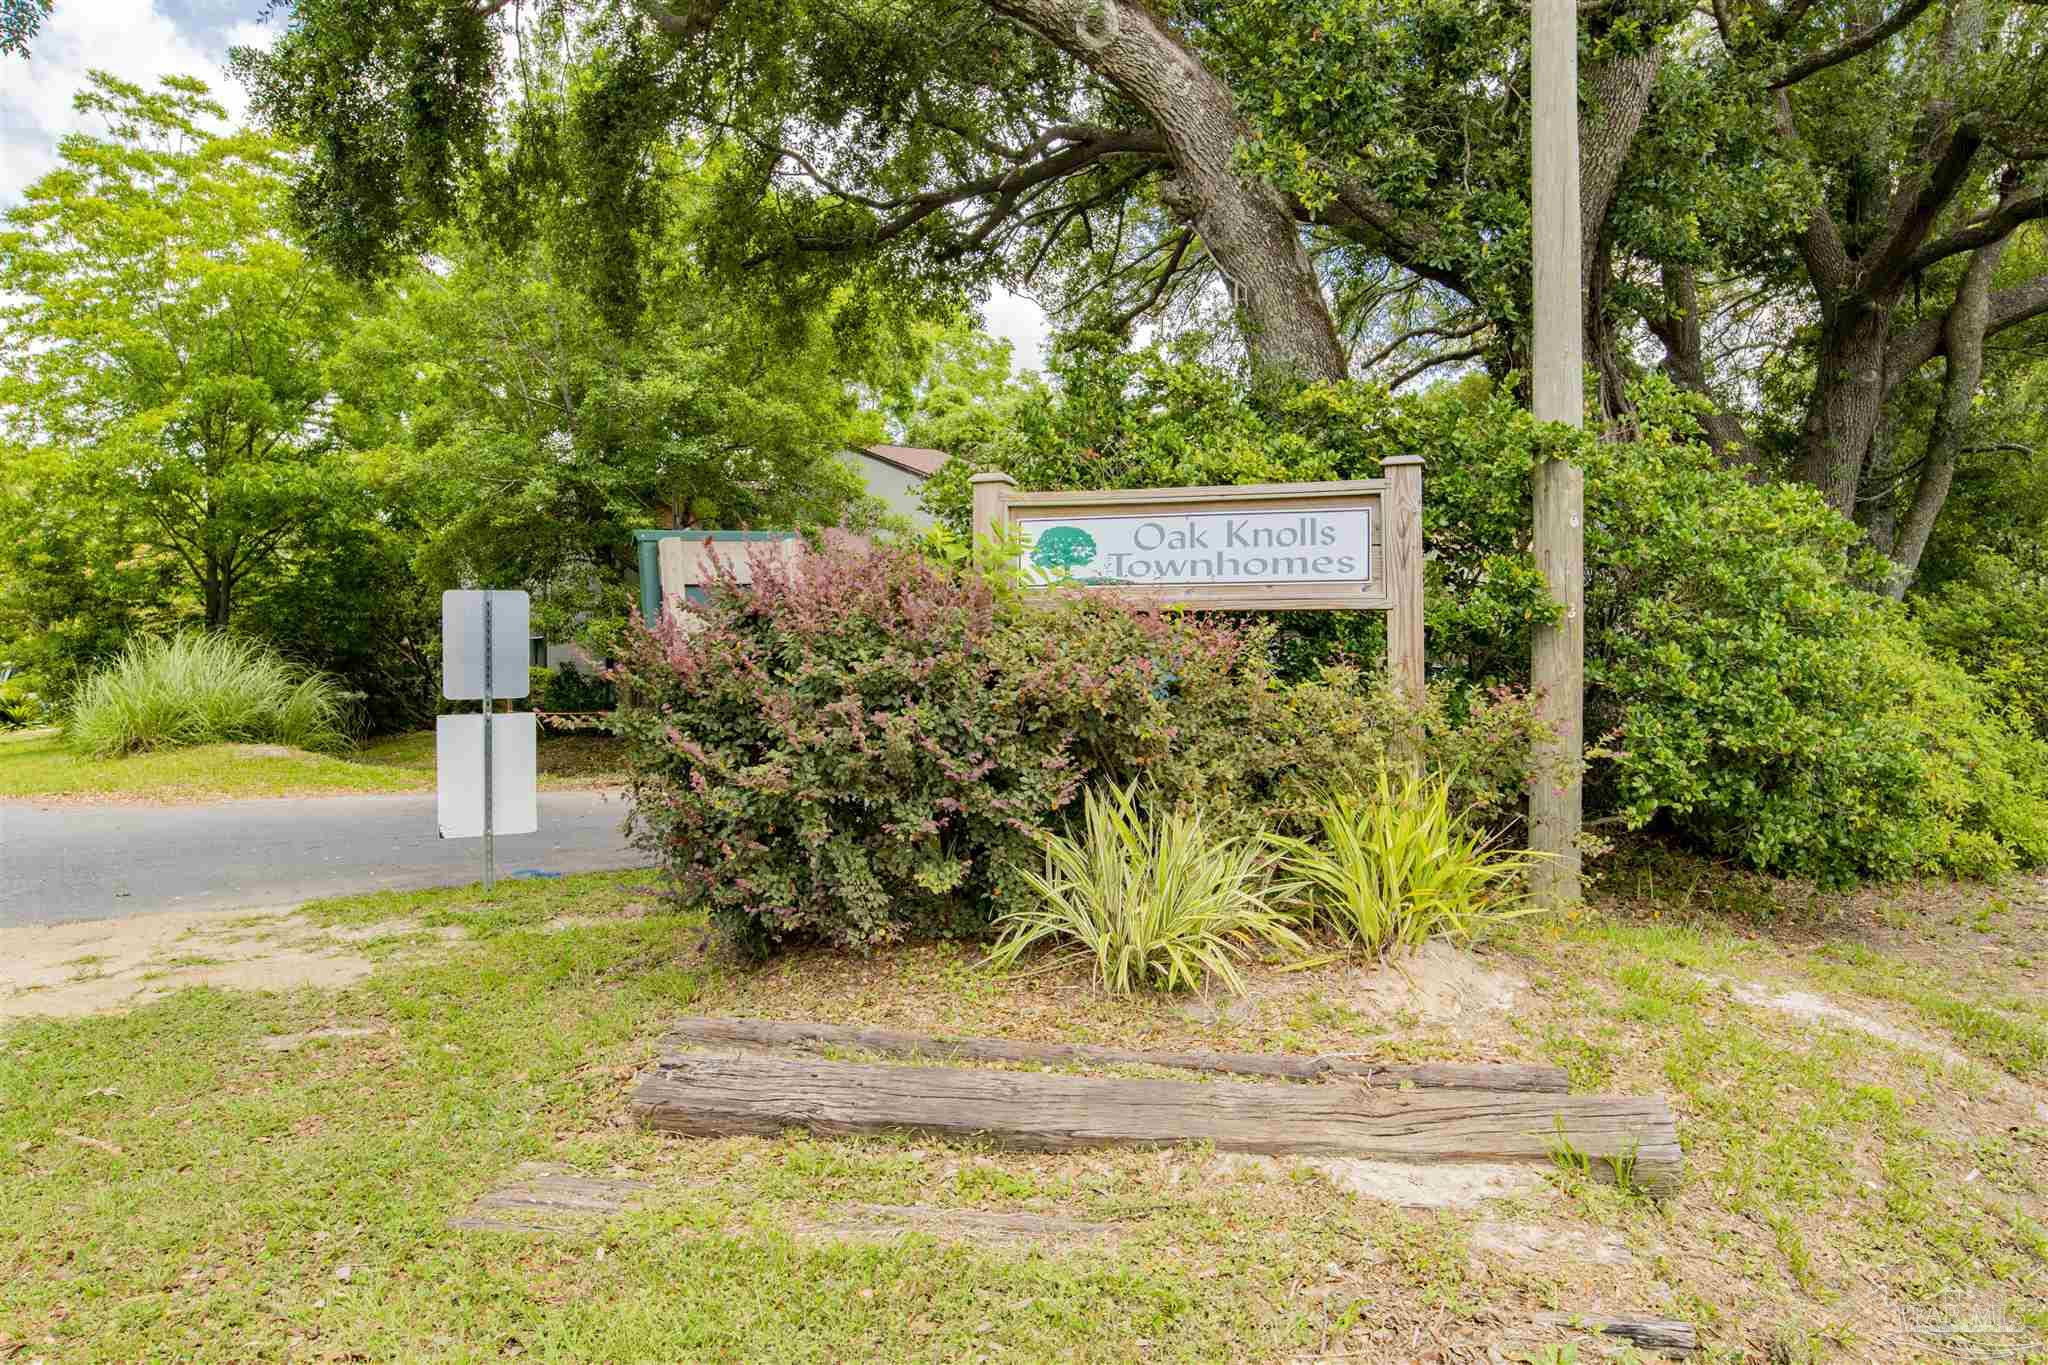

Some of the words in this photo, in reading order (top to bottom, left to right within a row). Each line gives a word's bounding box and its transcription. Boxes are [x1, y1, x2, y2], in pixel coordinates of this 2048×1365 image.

[1133, 521, 1208, 551] Oak
[1226, 517, 1336, 548] Knolls
[1109, 551, 1356, 578] Townhomes
